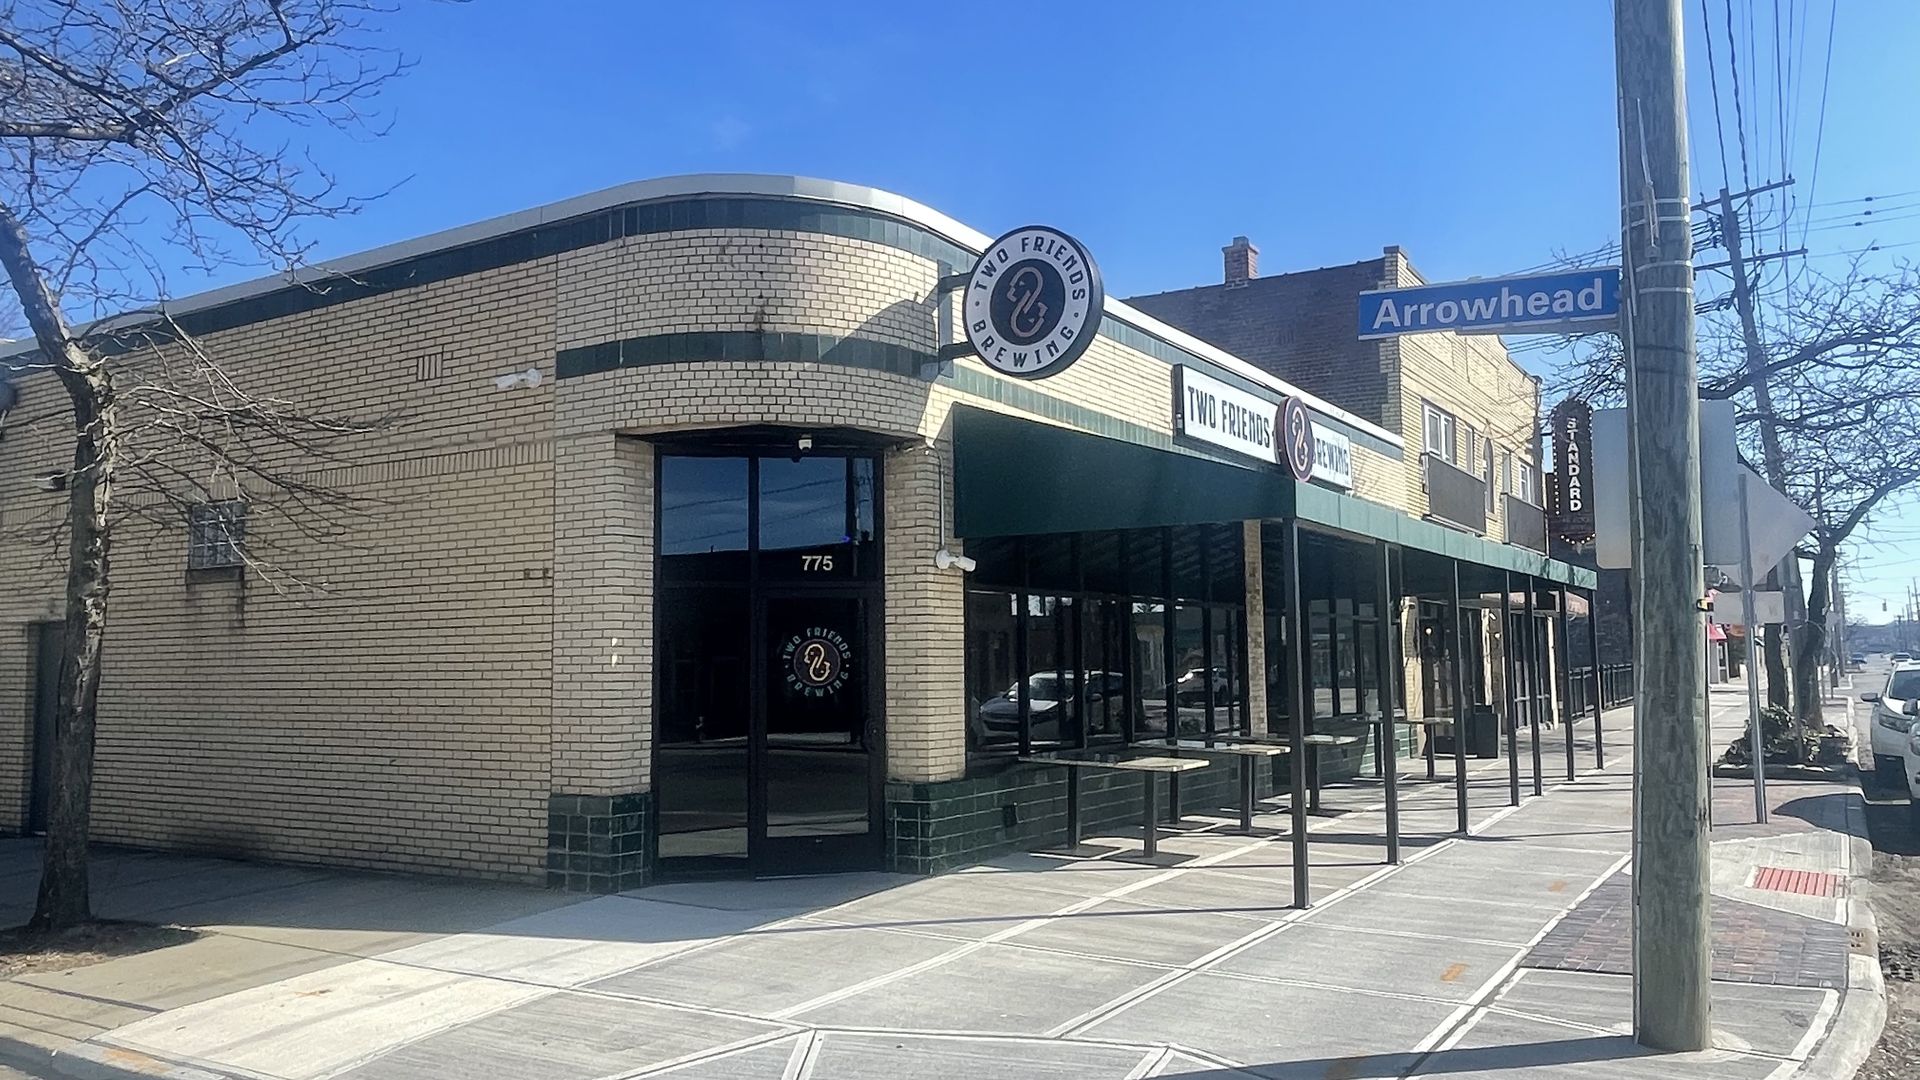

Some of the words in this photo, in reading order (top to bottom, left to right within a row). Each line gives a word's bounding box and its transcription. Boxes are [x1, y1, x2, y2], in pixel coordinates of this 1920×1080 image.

[974, 248, 1009, 291] TWO
[1021, 236, 1085, 301] FRIENDS
[1372, 278, 1602, 329] Arrowhead
[972, 319, 1074, 368] BREWING
[1187, 385, 1217, 429] TWO
[1221, 400, 1271, 449] FRIENDS
[1313, 437, 1349, 476] REWING
[1566, 417, 1582, 512] STANDARD
[801, 555, 833, 571] 775
[782, 635, 801, 660] TWO
[806, 627, 851, 659] FRIENDS
